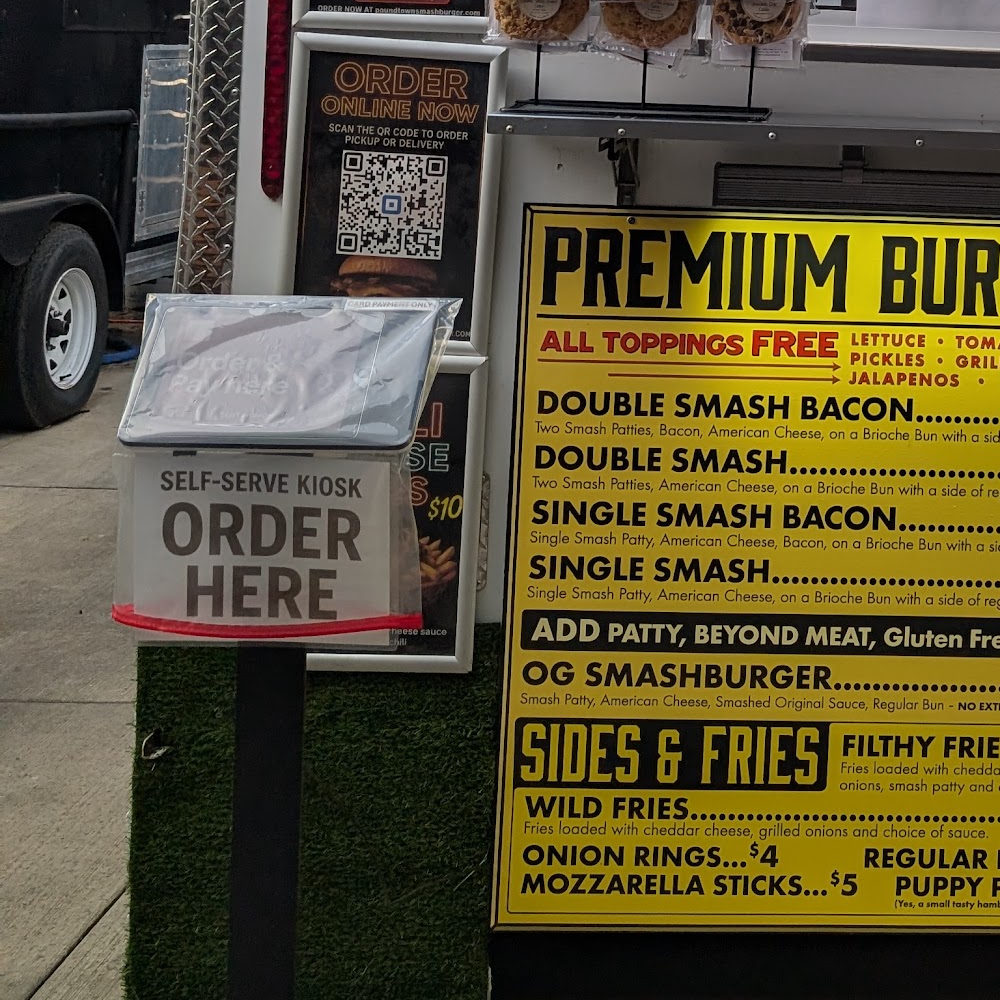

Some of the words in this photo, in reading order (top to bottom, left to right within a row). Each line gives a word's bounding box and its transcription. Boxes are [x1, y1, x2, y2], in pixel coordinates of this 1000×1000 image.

[334, 62, 469, 99] ORDER
[321, 96, 411, 120] ONLINE
[418, 102, 479, 123] NOW
[329, 123, 354, 133] SCAN
[357, 125, 375, 135] THE
[377, 126, 390, 136] QR
[393, 127, 419, 137] CODE
[422, 129, 434, 138] TO
[436, 130, 468, 140] ORDER
[345, 136, 380, 146] PICKUP
[383, 138, 397, 147] OR
[399, 139, 445, 150] DELIVERY
[541, 226, 850, 315] PREMIUM
[540, 330, 594, 353] ALL
[602, 332, 743, 356] TOPPINGS
[751, 330, 839, 358] FREE
[851, 333, 926, 348] LETTUCE
[851, 352, 925, 367] PICKLES
[848, 372, 960, 387] JALAPENOS
[537, 390, 665, 417] DOUBLE
[674, 393, 790, 420] SMASH
[535, 420, 559, 434] Two
[565, 422, 606, 436] Smash
[612, 423, 654, 438] Patties,
[659, 424, 704, 439] Bacon,
[708, 425, 769, 439] American
[774, 427, 824, 440] Cheese,
[829, 429, 846, 440] on
[850, 431, 858, 440] a
[863, 428, 910, 441] Brioche
[914, 430, 937, 442] Bun
[942, 430, 967, 443] with
[971, 434, 979, 443] a
[160, 470, 289, 494] SELF-SERVE
[297, 475, 362, 498] KIOSK
[428, 495, 462, 521] $10
[162, 502, 361, 561] ORDER
[186, 565, 338, 620] HERE
[531, 617, 600, 642] ADD
[608, 623, 687, 647] PATTY,
[694, 624, 799, 646] BEYOND
[805, 626, 876, 649] MEAT,
[884, 626, 962, 648] Gluten
[521, 723, 641, 783] SIDES
[657, 729, 682, 783] &
[700, 726, 820, 785] FRIES
[895, 900, 915, 910] (Yes,
[927, 900, 950, 909] small
[952, 901, 975, 911] tasty
